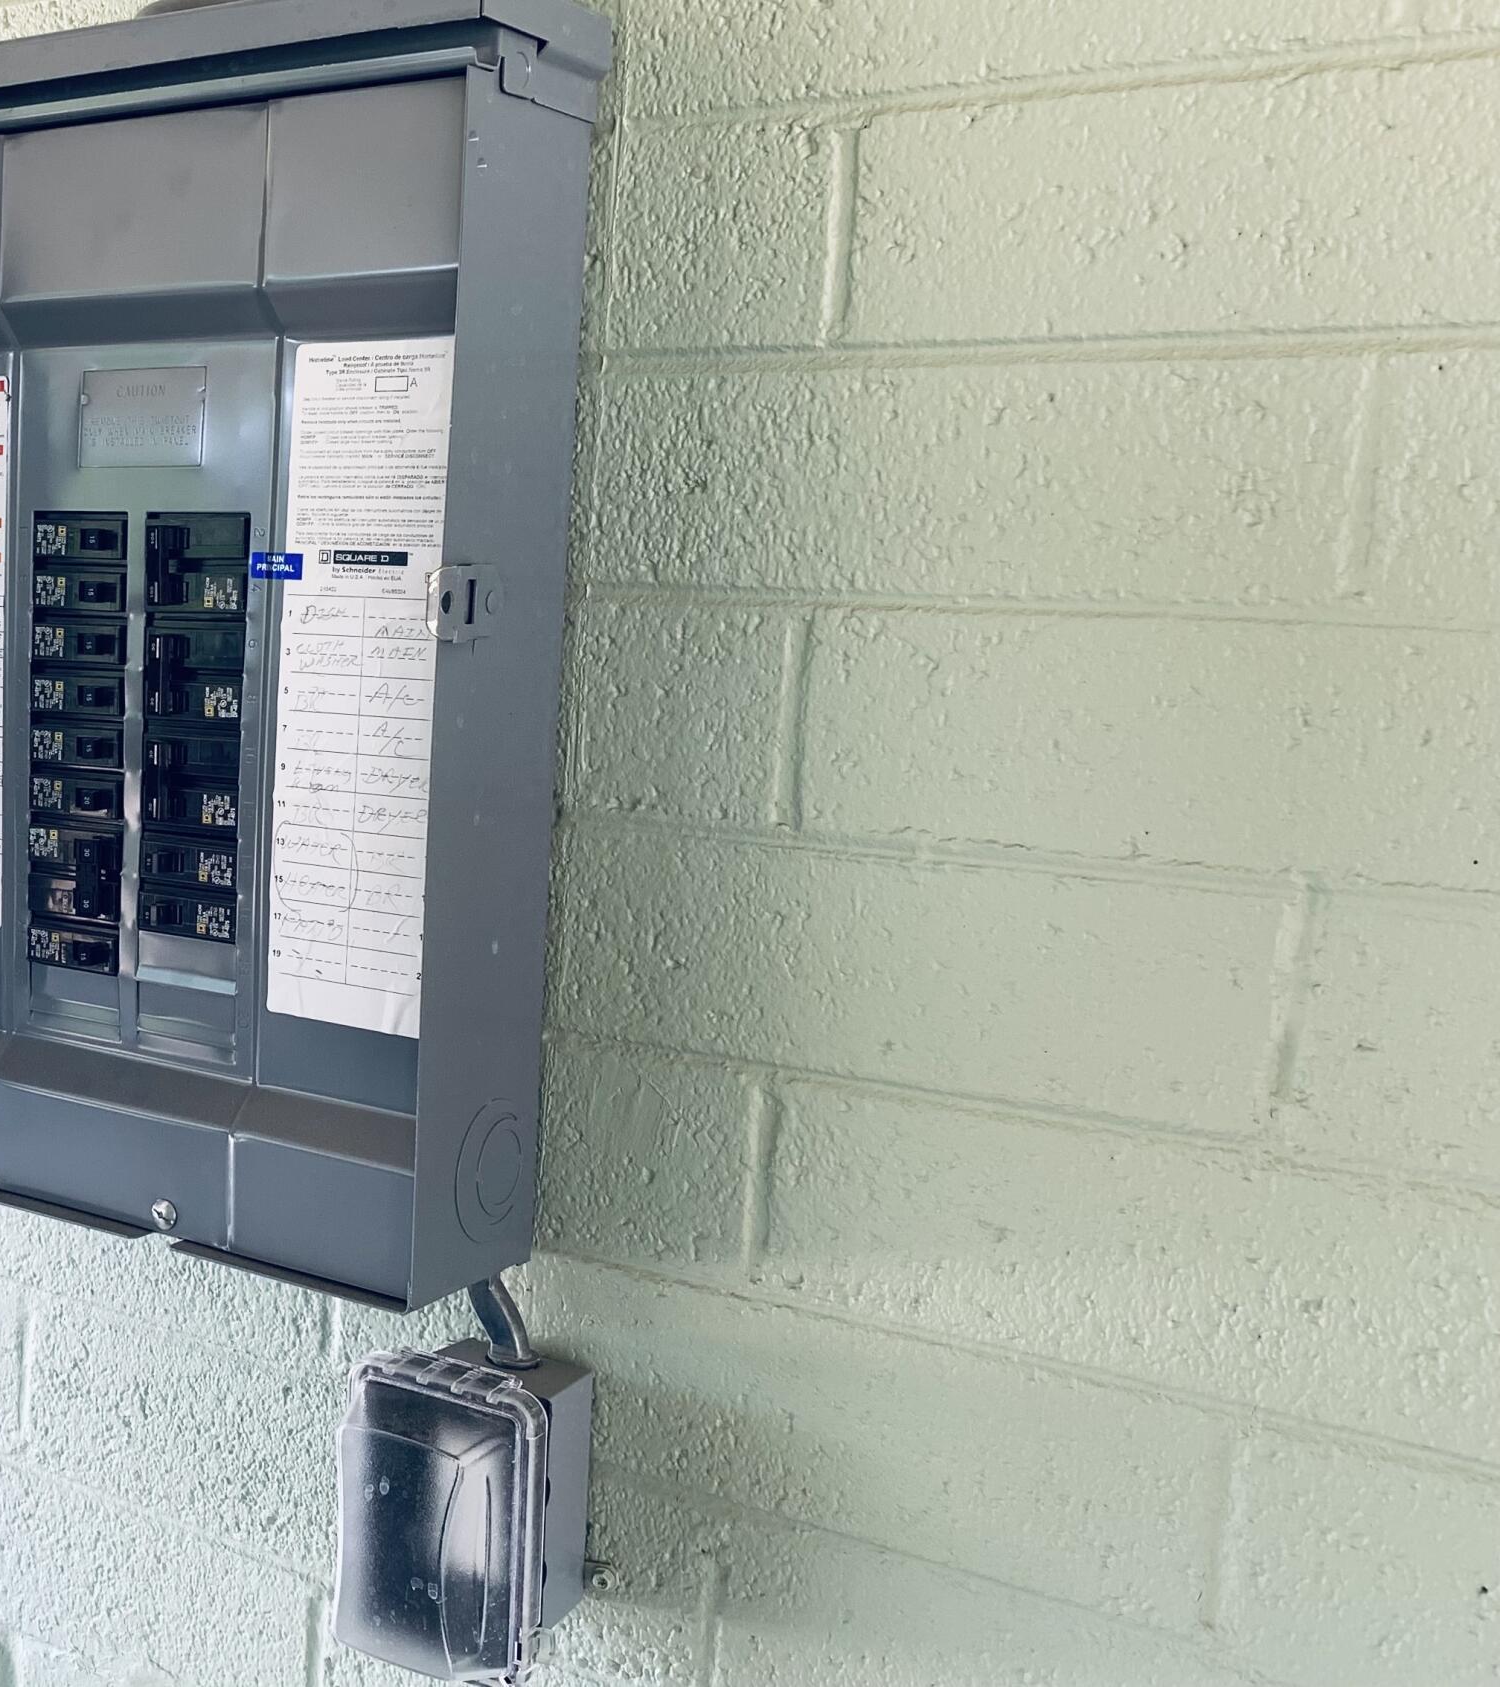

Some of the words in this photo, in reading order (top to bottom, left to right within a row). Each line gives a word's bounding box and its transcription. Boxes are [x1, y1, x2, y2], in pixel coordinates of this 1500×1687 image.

[410, 377, 418, 387] A
[116, 384, 166, 398] CAUTION
[160, 425, 197, 435] BREAKER
[161, 436, 189, 446] PANEL
[335, 553, 378, 563] SQUARE
[380, 555, 389, 563] D
[285, 648, 291, 656] 3
[371, 646, 427, 658] MAIN
[284, 687, 289, 695] 5
[282, 724, 287, 732] 7
[84, 796, 90, 805] 20
[276, 838, 285, 846] 13
[84, 848, 90, 857] 30
[274, 875, 284, 883] 15
[83, 899, 90, 909] 30
[273, 912, 282, 920] 17
[272, 950, 281, 958] 19
